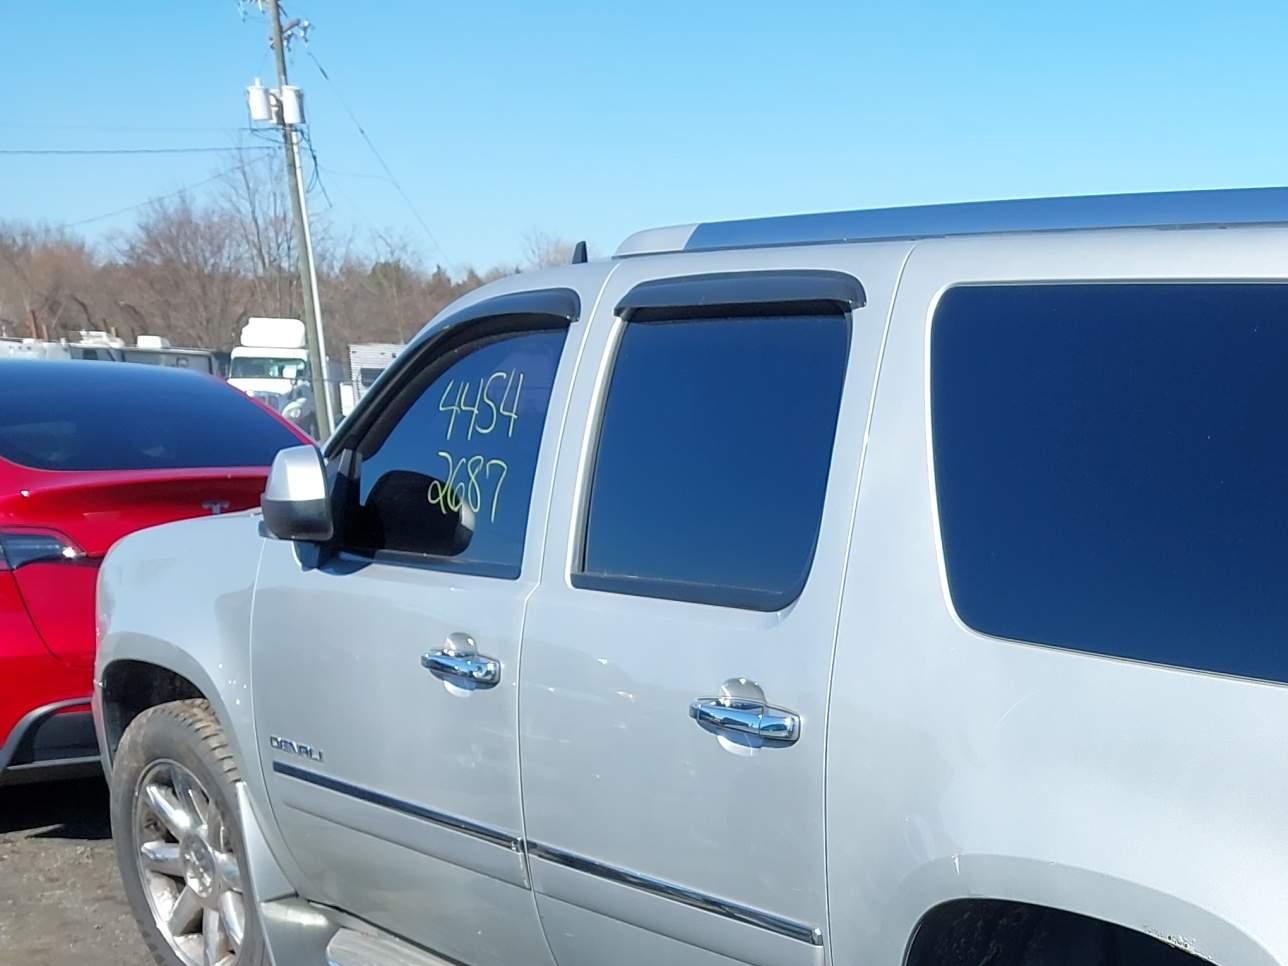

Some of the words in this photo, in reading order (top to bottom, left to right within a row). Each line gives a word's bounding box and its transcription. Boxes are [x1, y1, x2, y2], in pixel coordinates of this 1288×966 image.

[439, 368, 524, 441] 4454
[427, 451, 508, 524] 2687
[269, 735, 323, 761] DENALI
